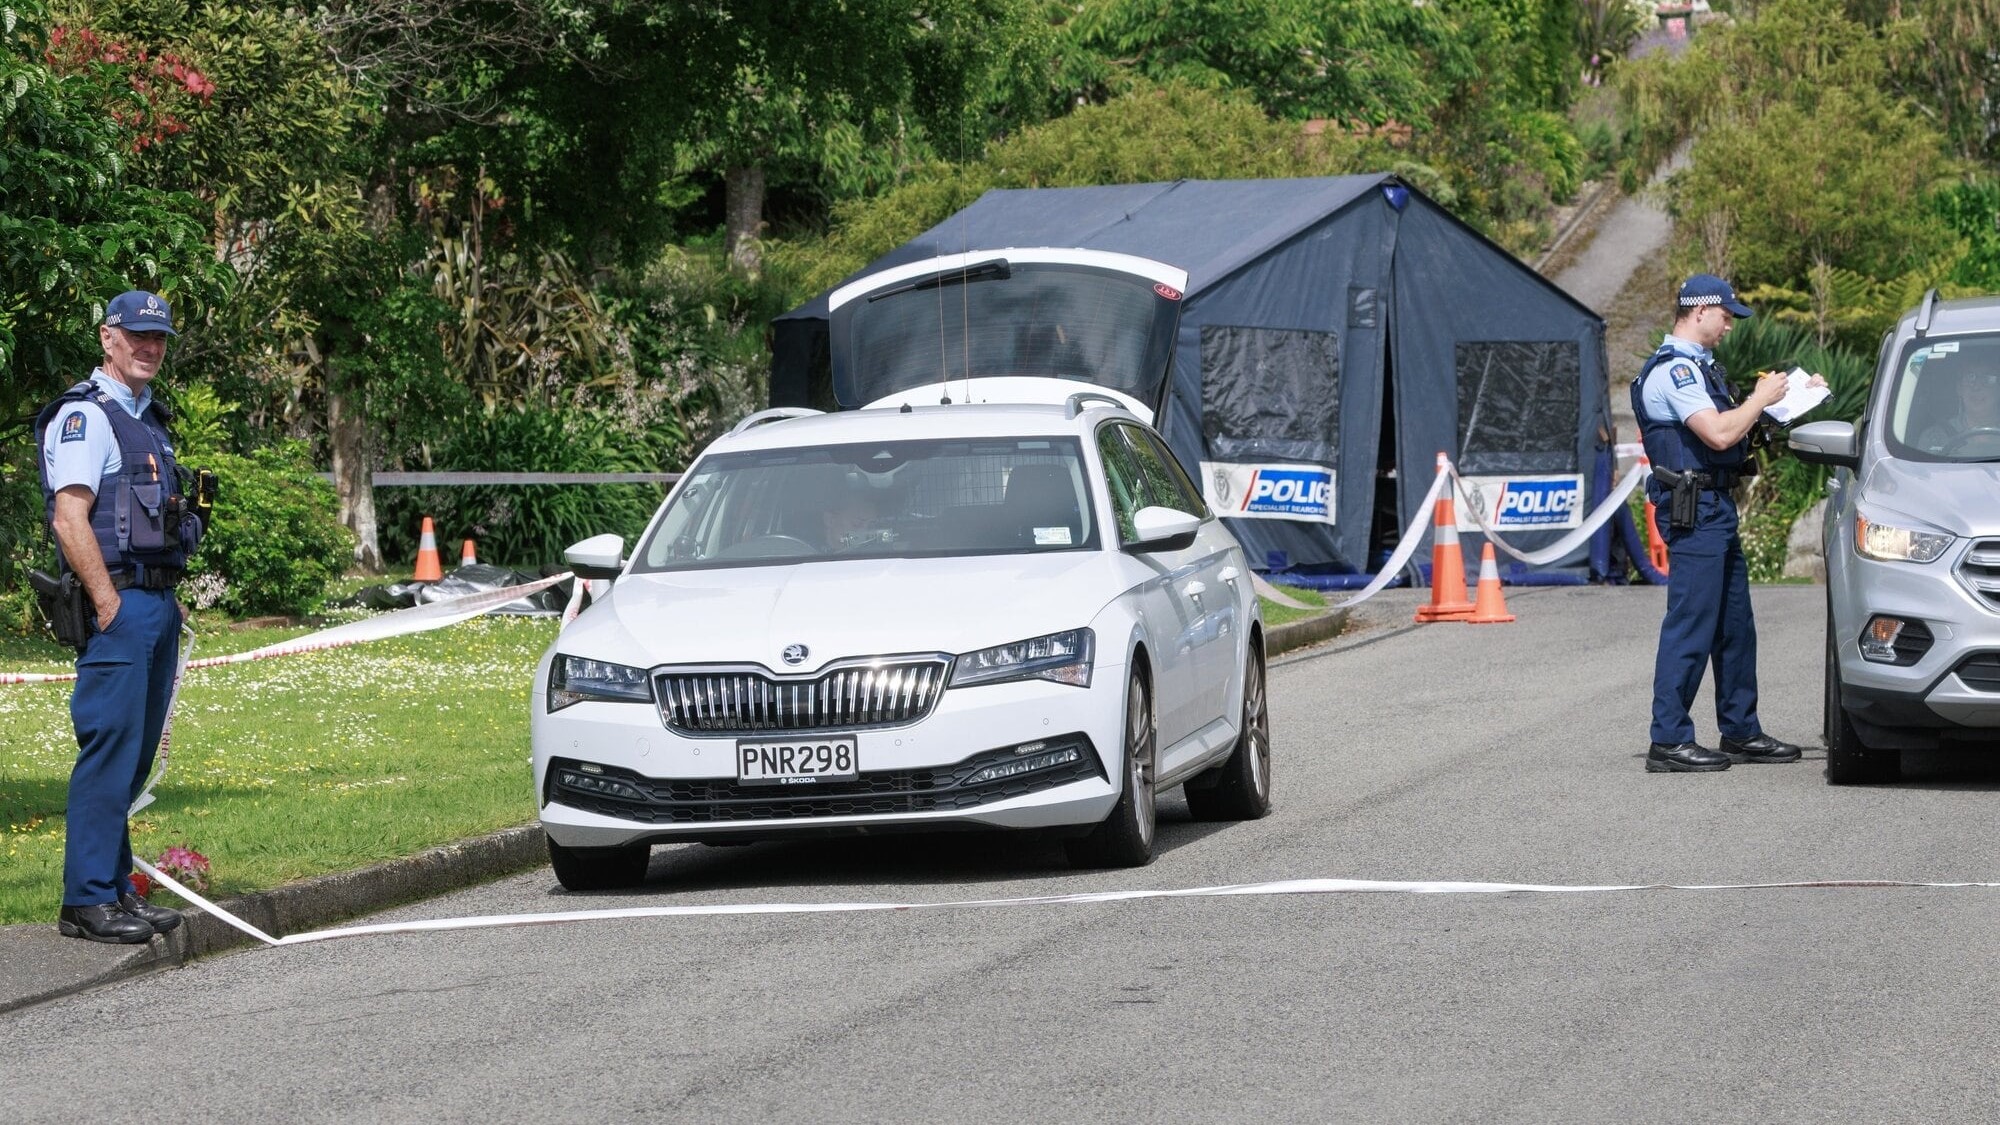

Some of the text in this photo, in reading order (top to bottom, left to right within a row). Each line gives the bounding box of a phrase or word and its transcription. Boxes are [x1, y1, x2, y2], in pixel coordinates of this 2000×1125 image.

[139, 308, 167, 319] POLICE
[1250, 479, 1330, 504] POLICE
[1501, 489, 1578, 514] POLICE
[1249, 504, 1290, 512] SPECIALIST
[1291, 505, 1318, 513] SEARCH
[742, 744, 851, 775] PNR298
